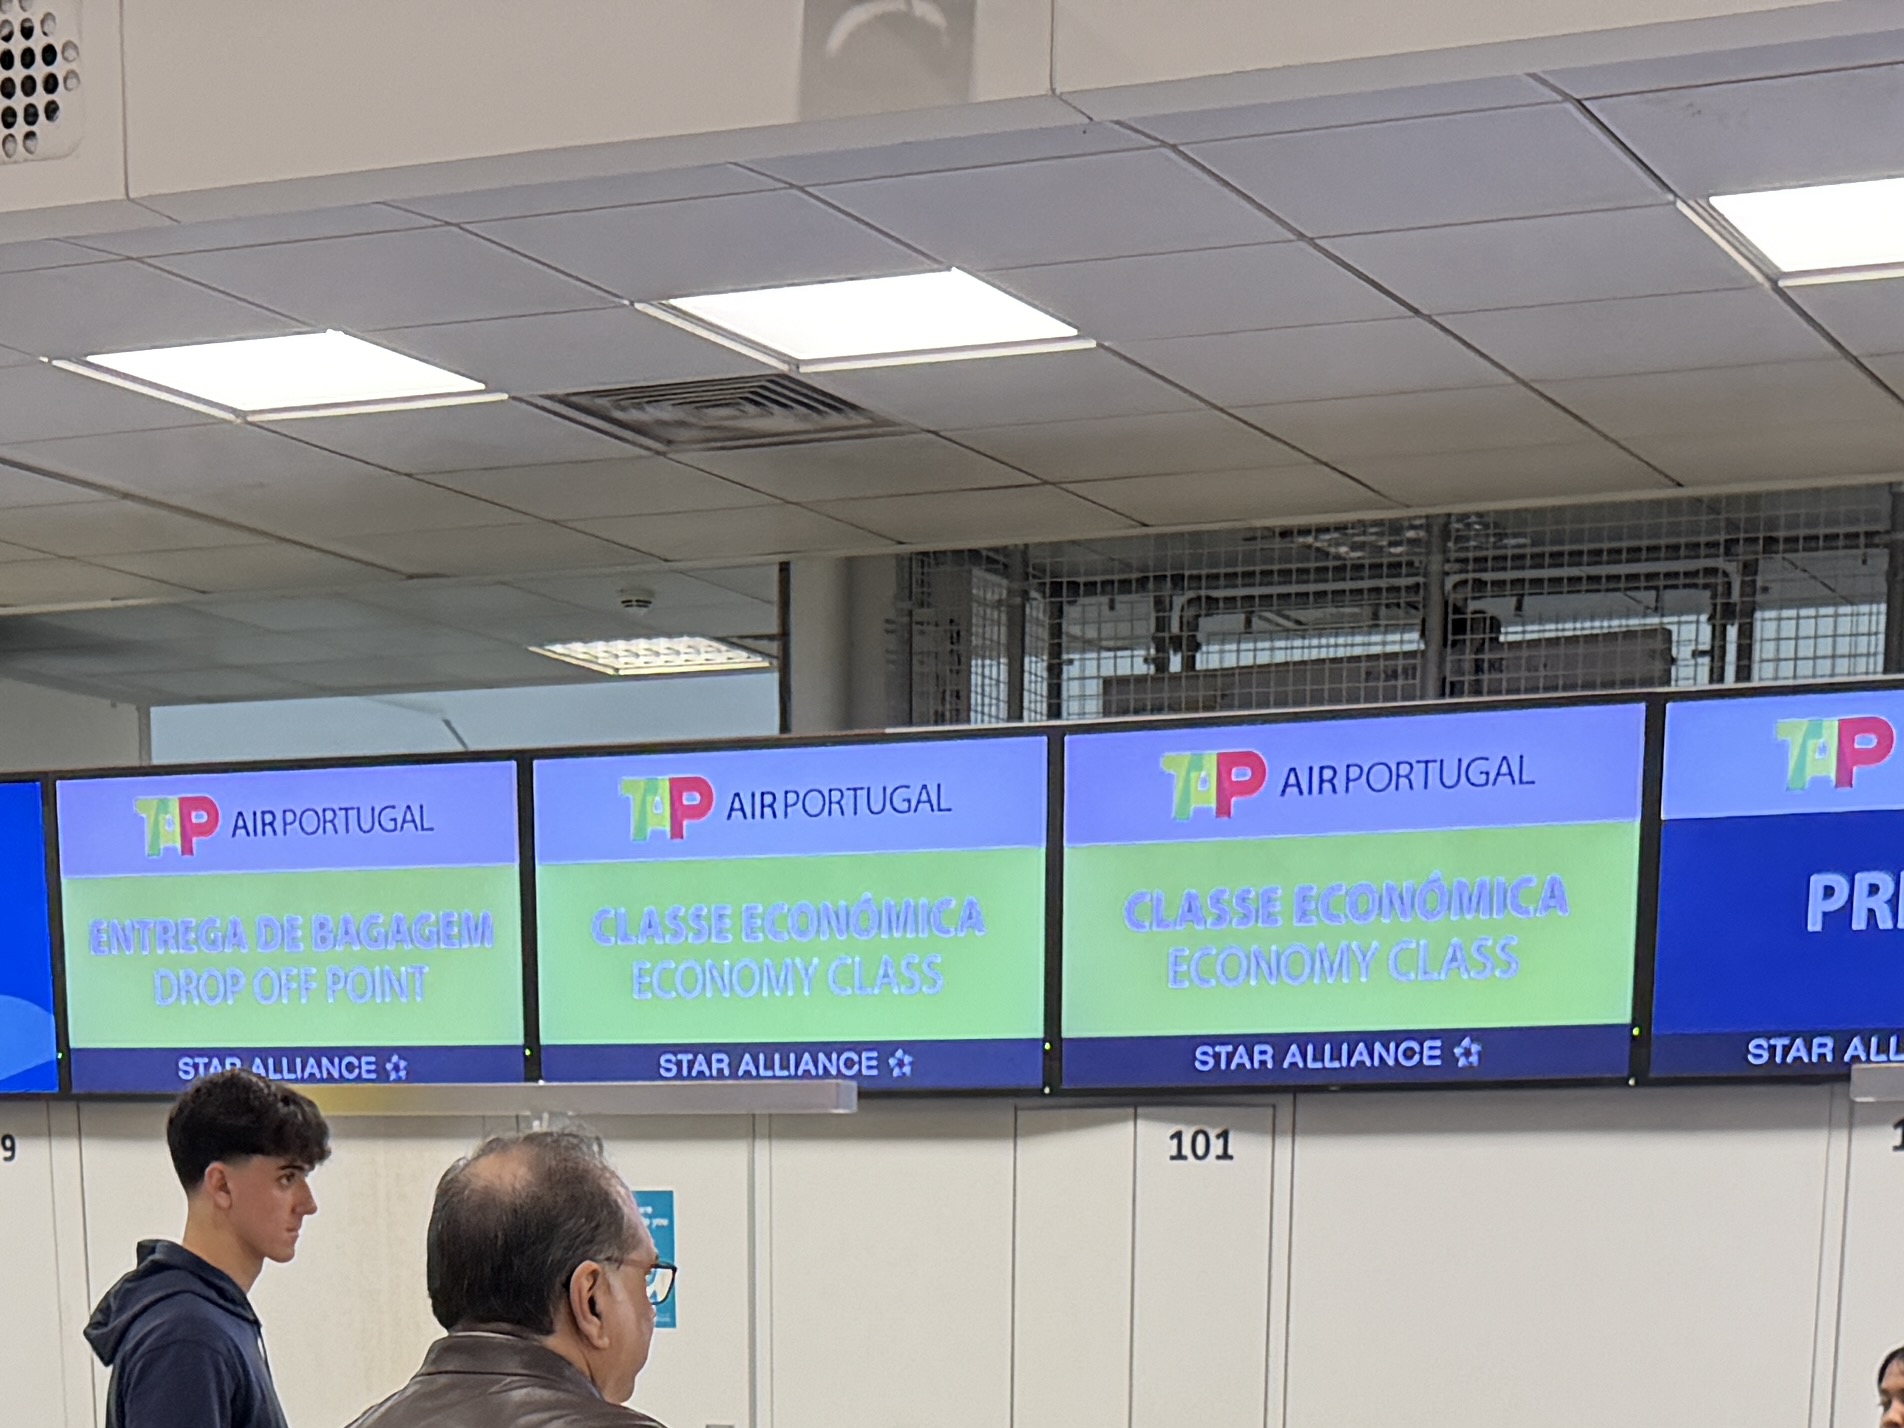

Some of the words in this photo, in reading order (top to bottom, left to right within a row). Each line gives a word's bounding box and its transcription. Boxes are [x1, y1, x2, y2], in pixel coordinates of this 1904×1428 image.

[1774, 715, 1895, 791] TAP
[619, 774, 715, 842] TAP
[1159, 748, 1267, 822] TAP
[133, 794, 220, 858] TAP
[592, 904, 733, 946] CLASSE
[741, 892, 987, 943] ECONÓMICA
[1123, 885, 1283, 932] CLASSE
[1292, 870, 1570, 927] ECONÓMICA
[89, 914, 247, 957] ENTREGA
[255, 913, 305, 953] DE
[311, 909, 494, 952] BAGAGEM
[154, 966, 246, 1008] DROP
[252, 966, 316, 1004] OFF
[326, 964, 429, 1003] POINT
[632, 956, 819, 1000] ECONOMY
[827, 953, 944, 997] CLASS
[1167, 939, 1379, 990] ECONOMY
[1388, 935, 1520, 982] CLASS
[251, 1054, 377, 1081] ALLIANCE
[659, 1053, 730, 1077] STAR
[737, 1050, 879, 1077] ALLIANCE
[1194, 1044, 1274, 1071] STAR
[1282, 1039, 1442, 1070] ALLIANCE
[1747, 1036, 1833, 1065] STAR
[1169, 1127, 1235, 1161] 101
